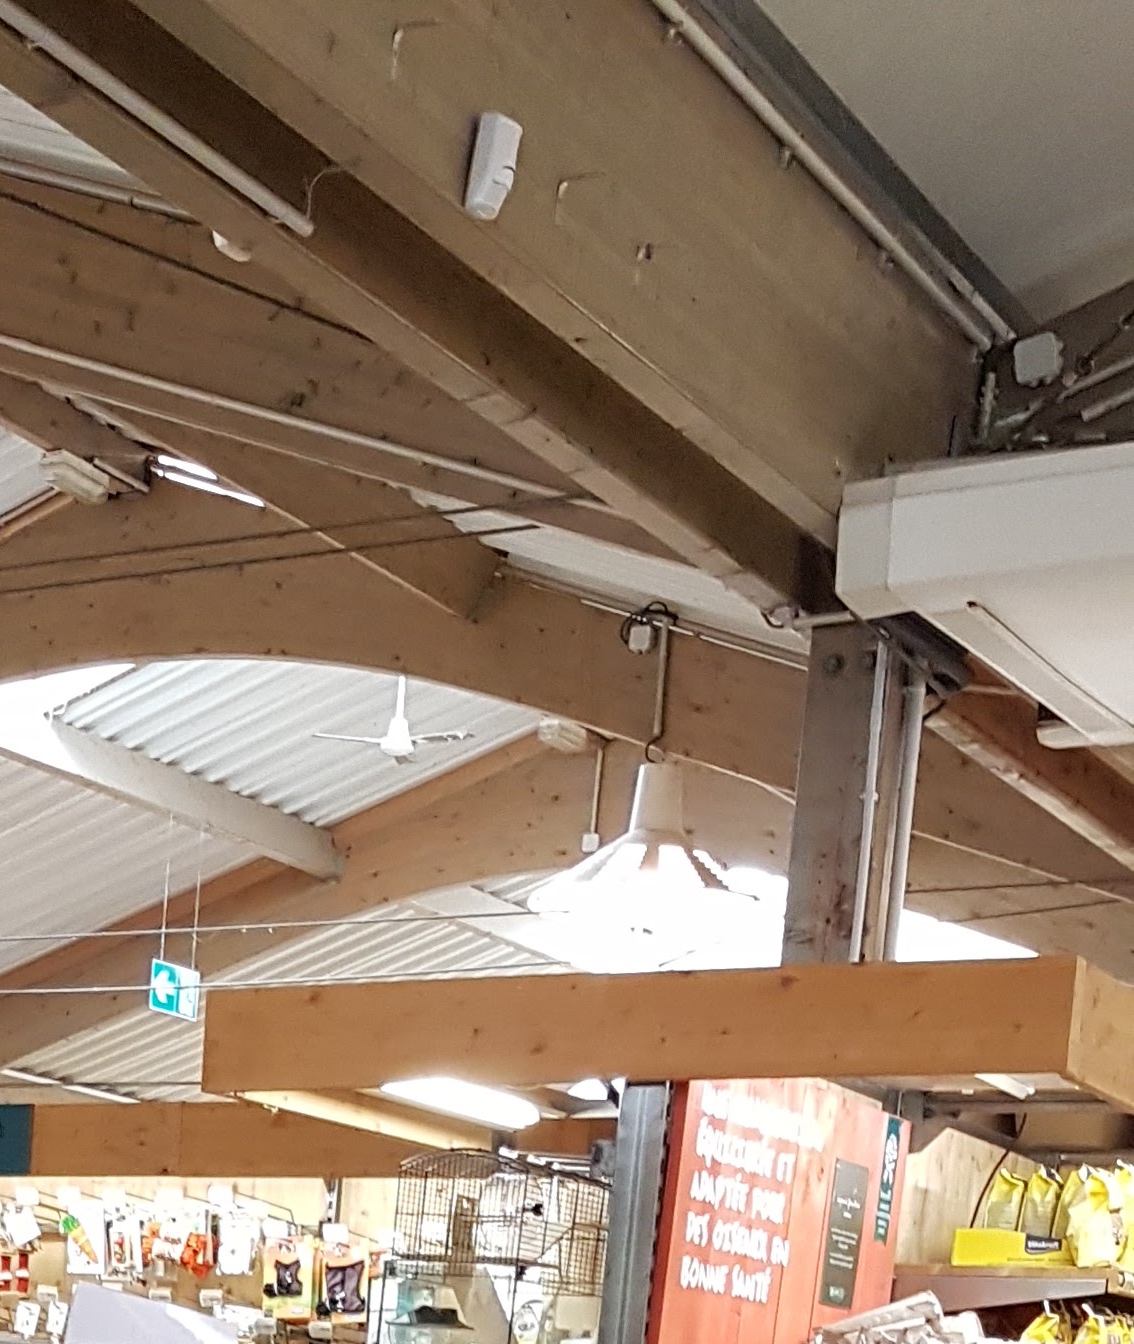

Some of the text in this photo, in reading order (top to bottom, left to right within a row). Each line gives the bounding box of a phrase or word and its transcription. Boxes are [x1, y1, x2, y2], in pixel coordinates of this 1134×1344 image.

[777, 1152, 796, 1184] ET
[690, 1170, 786, 1225] ADAPTÉE POUR
[685, 1211, 710, 1248] DES
[712, 1218, 768, 1264] OISEAUX
[770, 1235, 790, 1267] EN
[680, 1255, 771, 1304] BONNE SANTÉ
